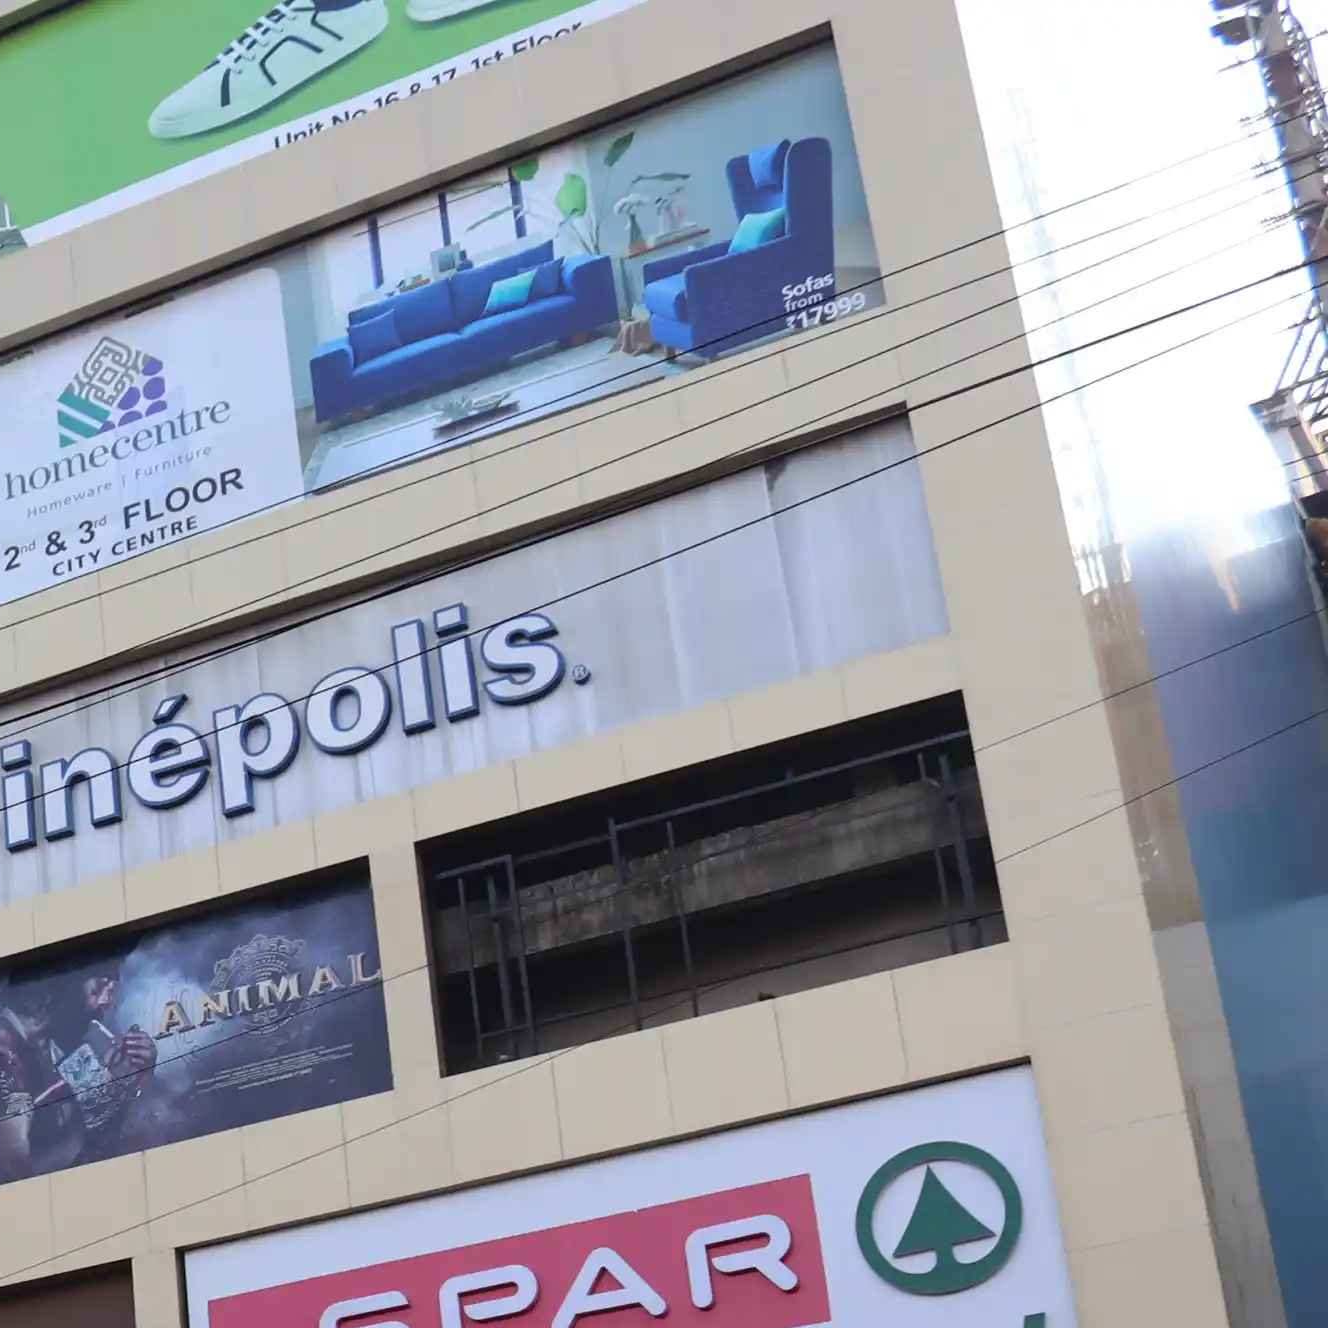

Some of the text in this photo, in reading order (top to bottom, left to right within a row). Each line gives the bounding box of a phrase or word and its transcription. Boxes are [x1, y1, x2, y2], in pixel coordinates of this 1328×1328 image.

[781, 273, 834, 300] Sofas
[784, 293, 823, 313] from
[4, 400, 231, 500] homecentre
[27, 446, 212, 518] Homeware Furniture
[4, 468, 245, 571] 2nd & 3rd FLOOR
[52, 515, 198, 577] CITY CENTRE
[154, 952, 380, 1041] ANIMAL
